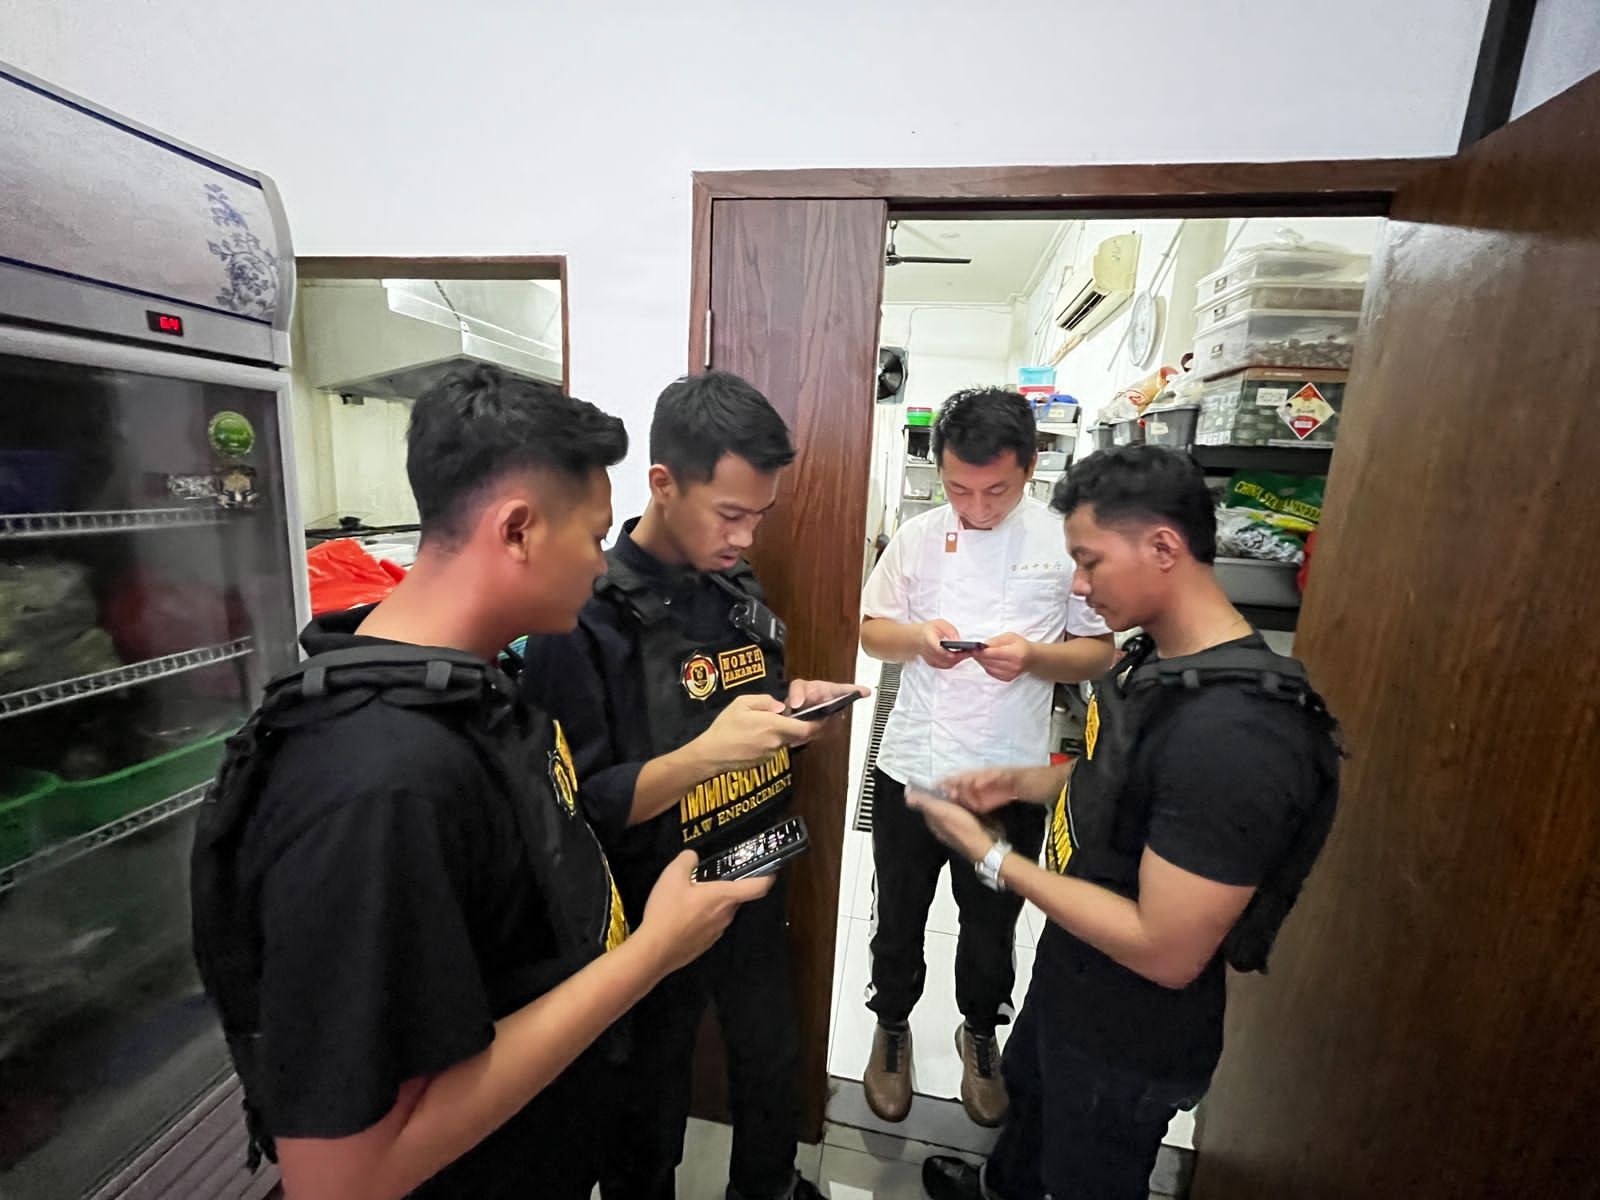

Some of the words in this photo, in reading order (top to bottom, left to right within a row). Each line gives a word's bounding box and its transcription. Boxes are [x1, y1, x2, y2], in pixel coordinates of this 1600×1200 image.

[722, 649, 761, 670] NORTH
[725, 663, 763, 682] JAKARTA
[680, 746, 790, 824] IMMIGRATION
[682, 817, 712, 843] LAW
[717, 773, 792, 826] ENFORCEMENT
